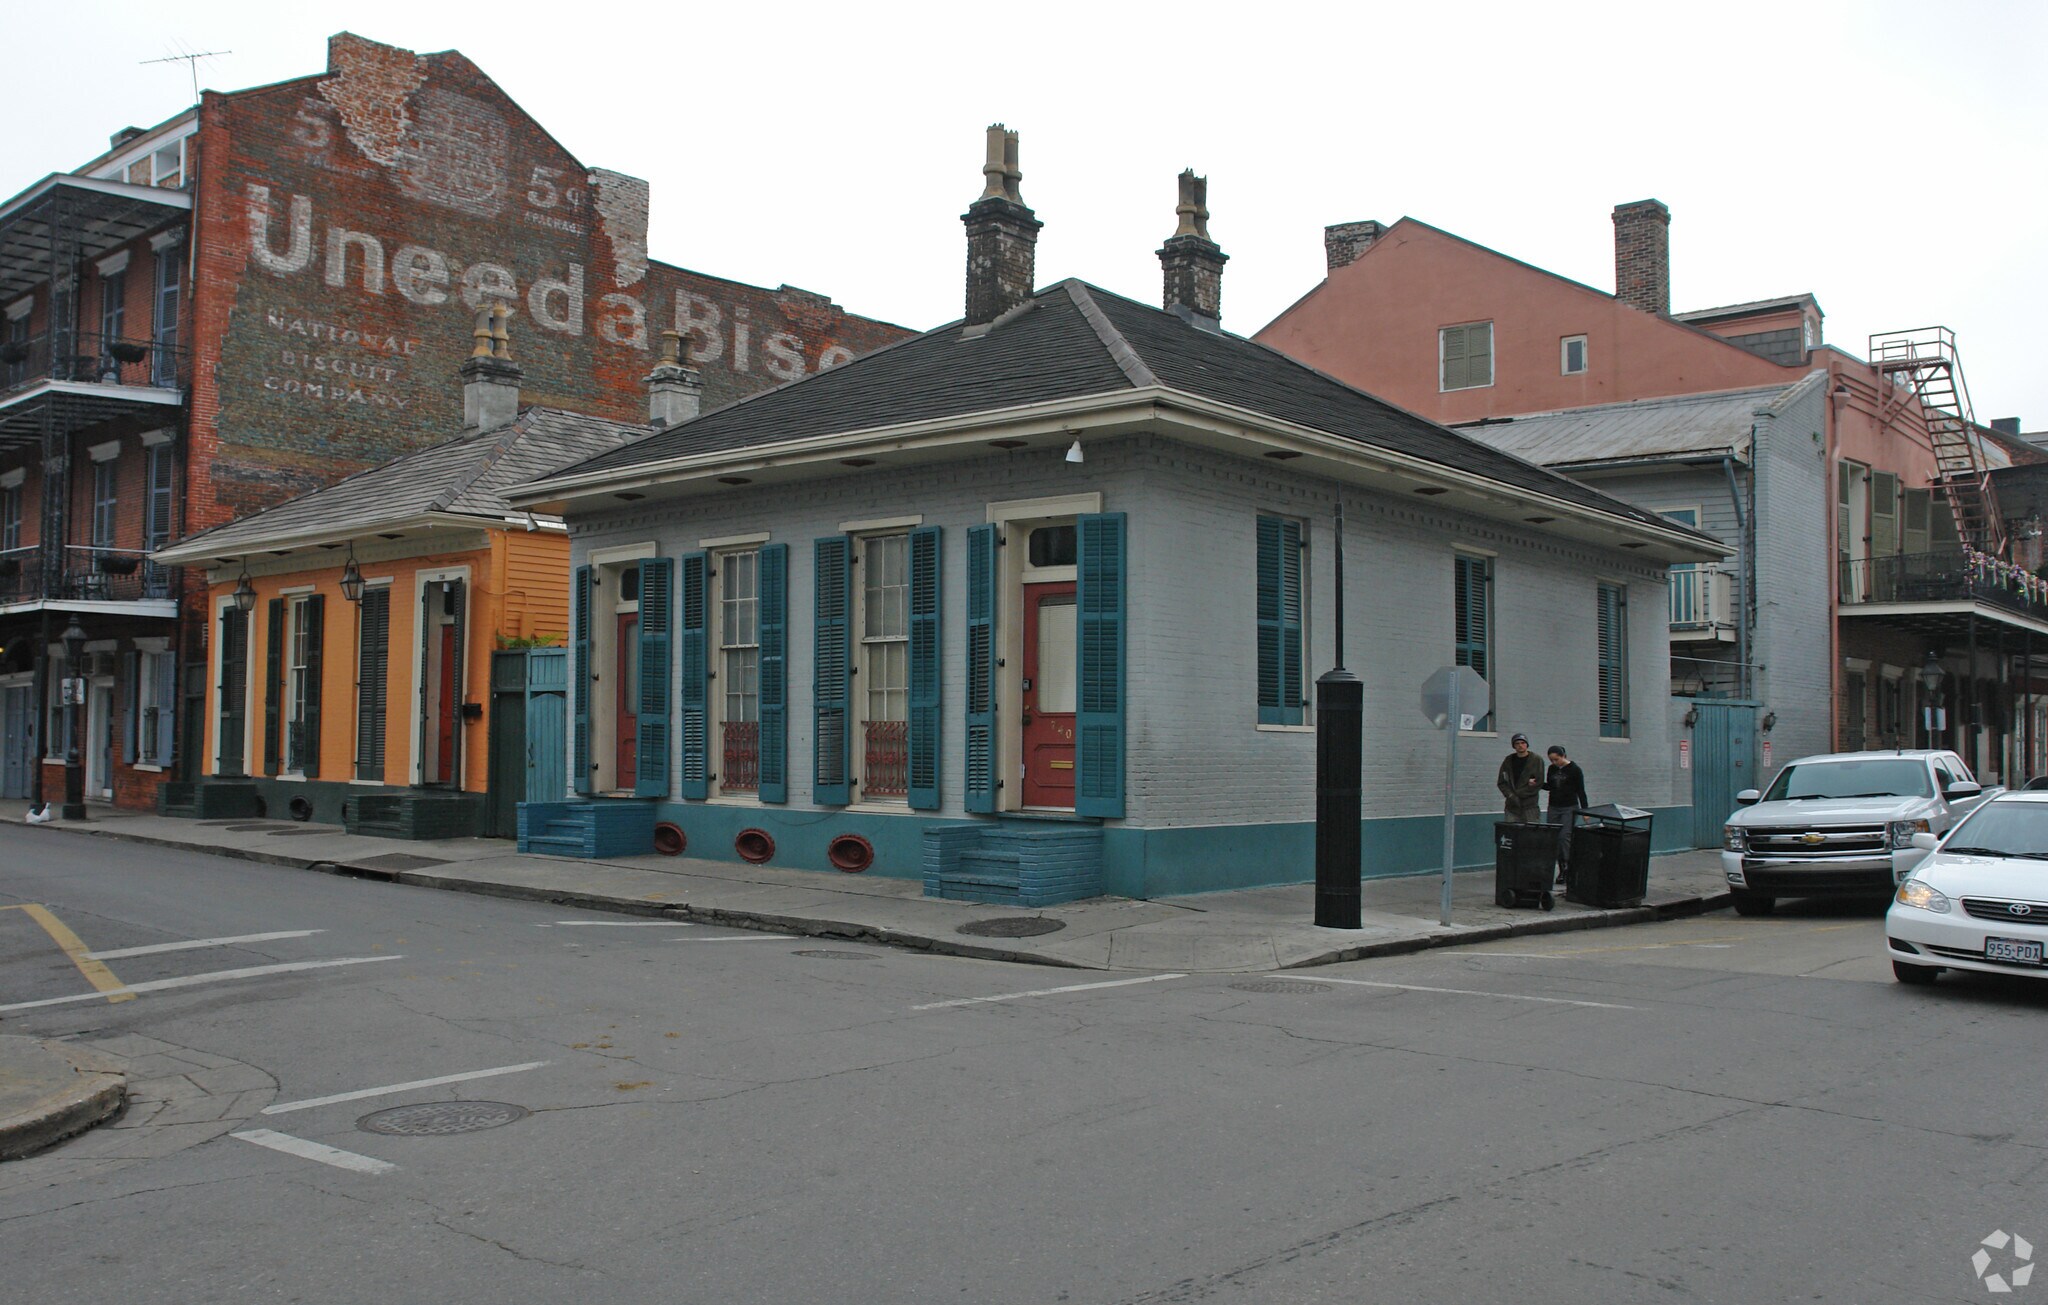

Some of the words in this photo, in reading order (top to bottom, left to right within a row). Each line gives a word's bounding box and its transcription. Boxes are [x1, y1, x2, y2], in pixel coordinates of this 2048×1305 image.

[246, 183, 650, 351] Uneeda
[267, 313, 417, 356] NATIONAL
[282, 351, 397, 382] BISCUIT
[264, 376, 410, 409] COMPANY
